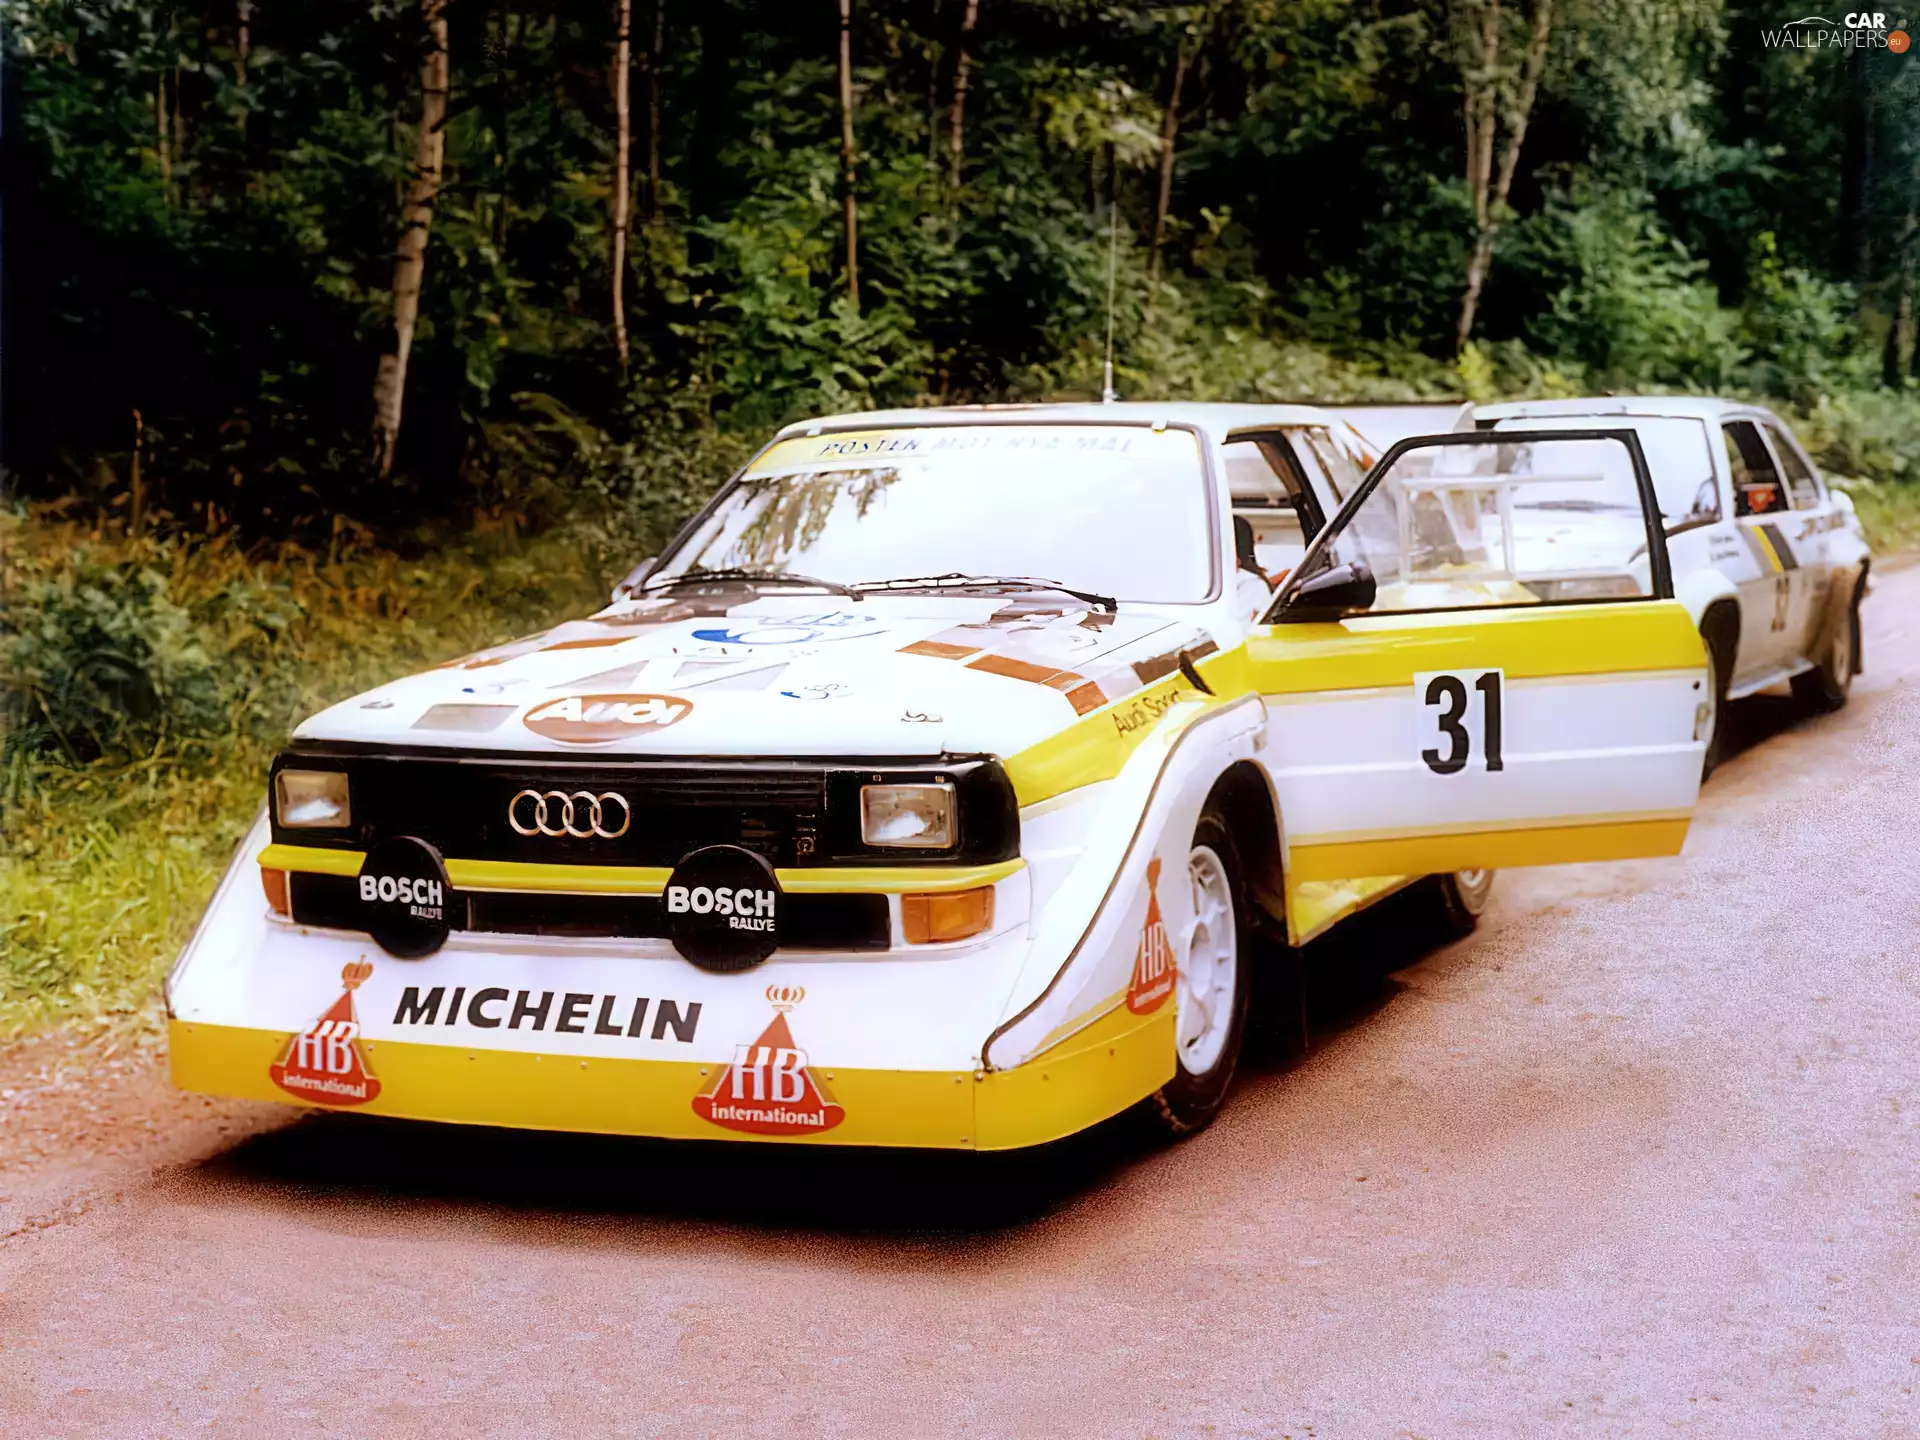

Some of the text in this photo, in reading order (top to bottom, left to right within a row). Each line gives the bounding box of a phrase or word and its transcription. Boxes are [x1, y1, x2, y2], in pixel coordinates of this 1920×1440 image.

[1422, 672, 1503, 775] 31
[360, 875, 443, 906] BOSCH
[668, 886, 775, 917] BOSCH
[729, 916, 775, 932] RALLYE
[1140, 921, 1165, 984] HB
[393, 987, 703, 1043] MICHELIN
[297, 1019, 359, 1075] HB
[283, 1070, 366, 1099] international
[731, 1045, 808, 1103] HB
[711, 1102, 825, 1126] international
